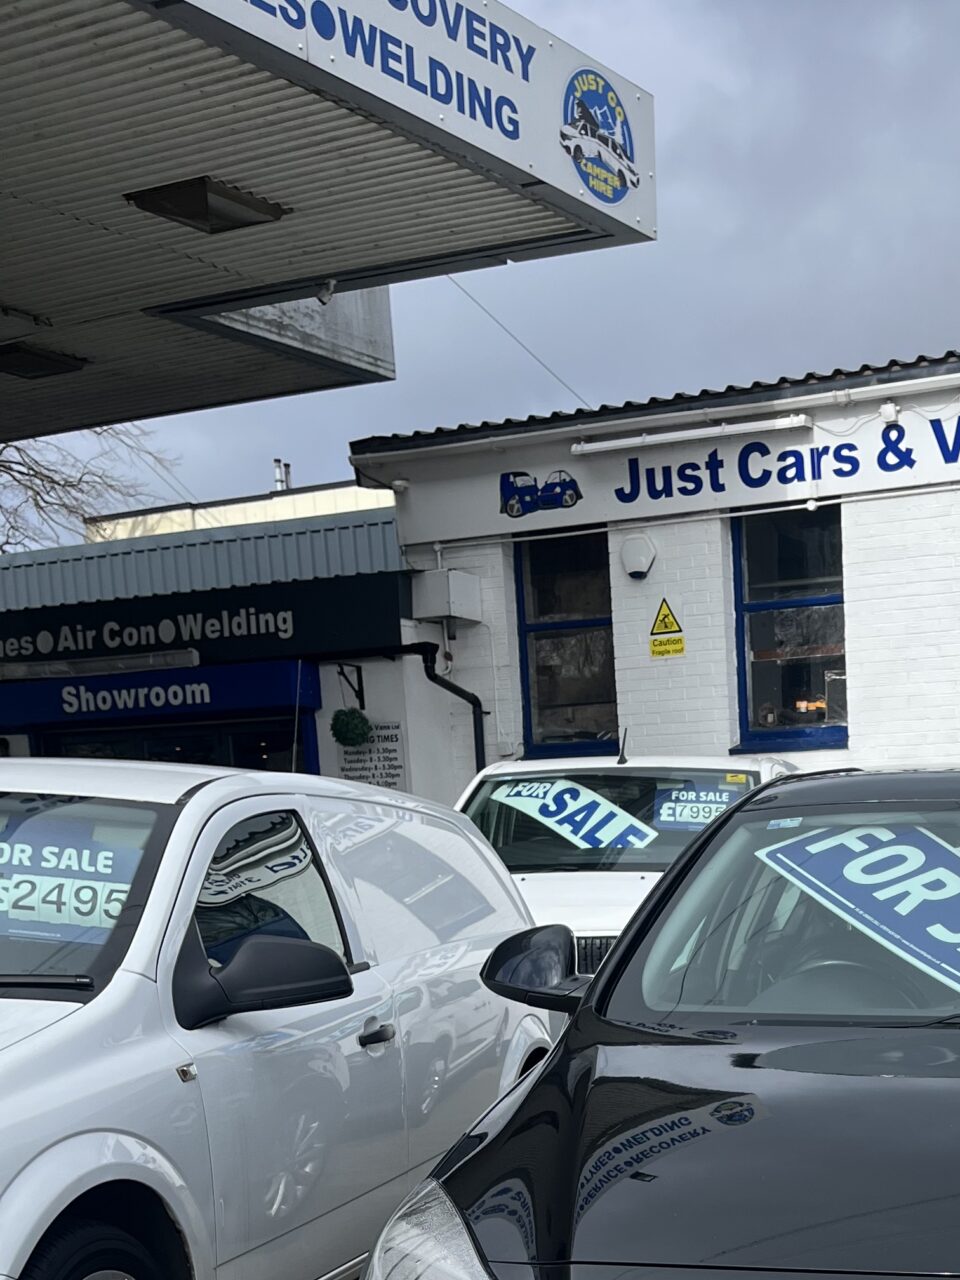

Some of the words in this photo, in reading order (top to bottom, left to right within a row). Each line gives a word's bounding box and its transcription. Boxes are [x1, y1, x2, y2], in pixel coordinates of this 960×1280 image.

[387, 0, 536, 82] OVERY
[337, 6, 520, 141] WELDING
[574, 74, 605, 98] JUST
[589, 175, 613, 199] HIRE
[614, 448, 726, 504] Just
[737, 440, 860, 489] Cars
[876, 424, 917, 474] &
[57, 624, 97, 651] Air
[103, 621, 155, 648] Con
[177, 607, 294, 640] Welding
[652, 638, 682, 647] Caution
[61, 682, 211, 713] Showroom
[377, 734, 399, 743] TIMES
[671, 791, 696, 801] FOR
[699, 792, 729, 801] SALE
[41, 846, 114, 874] SALE
